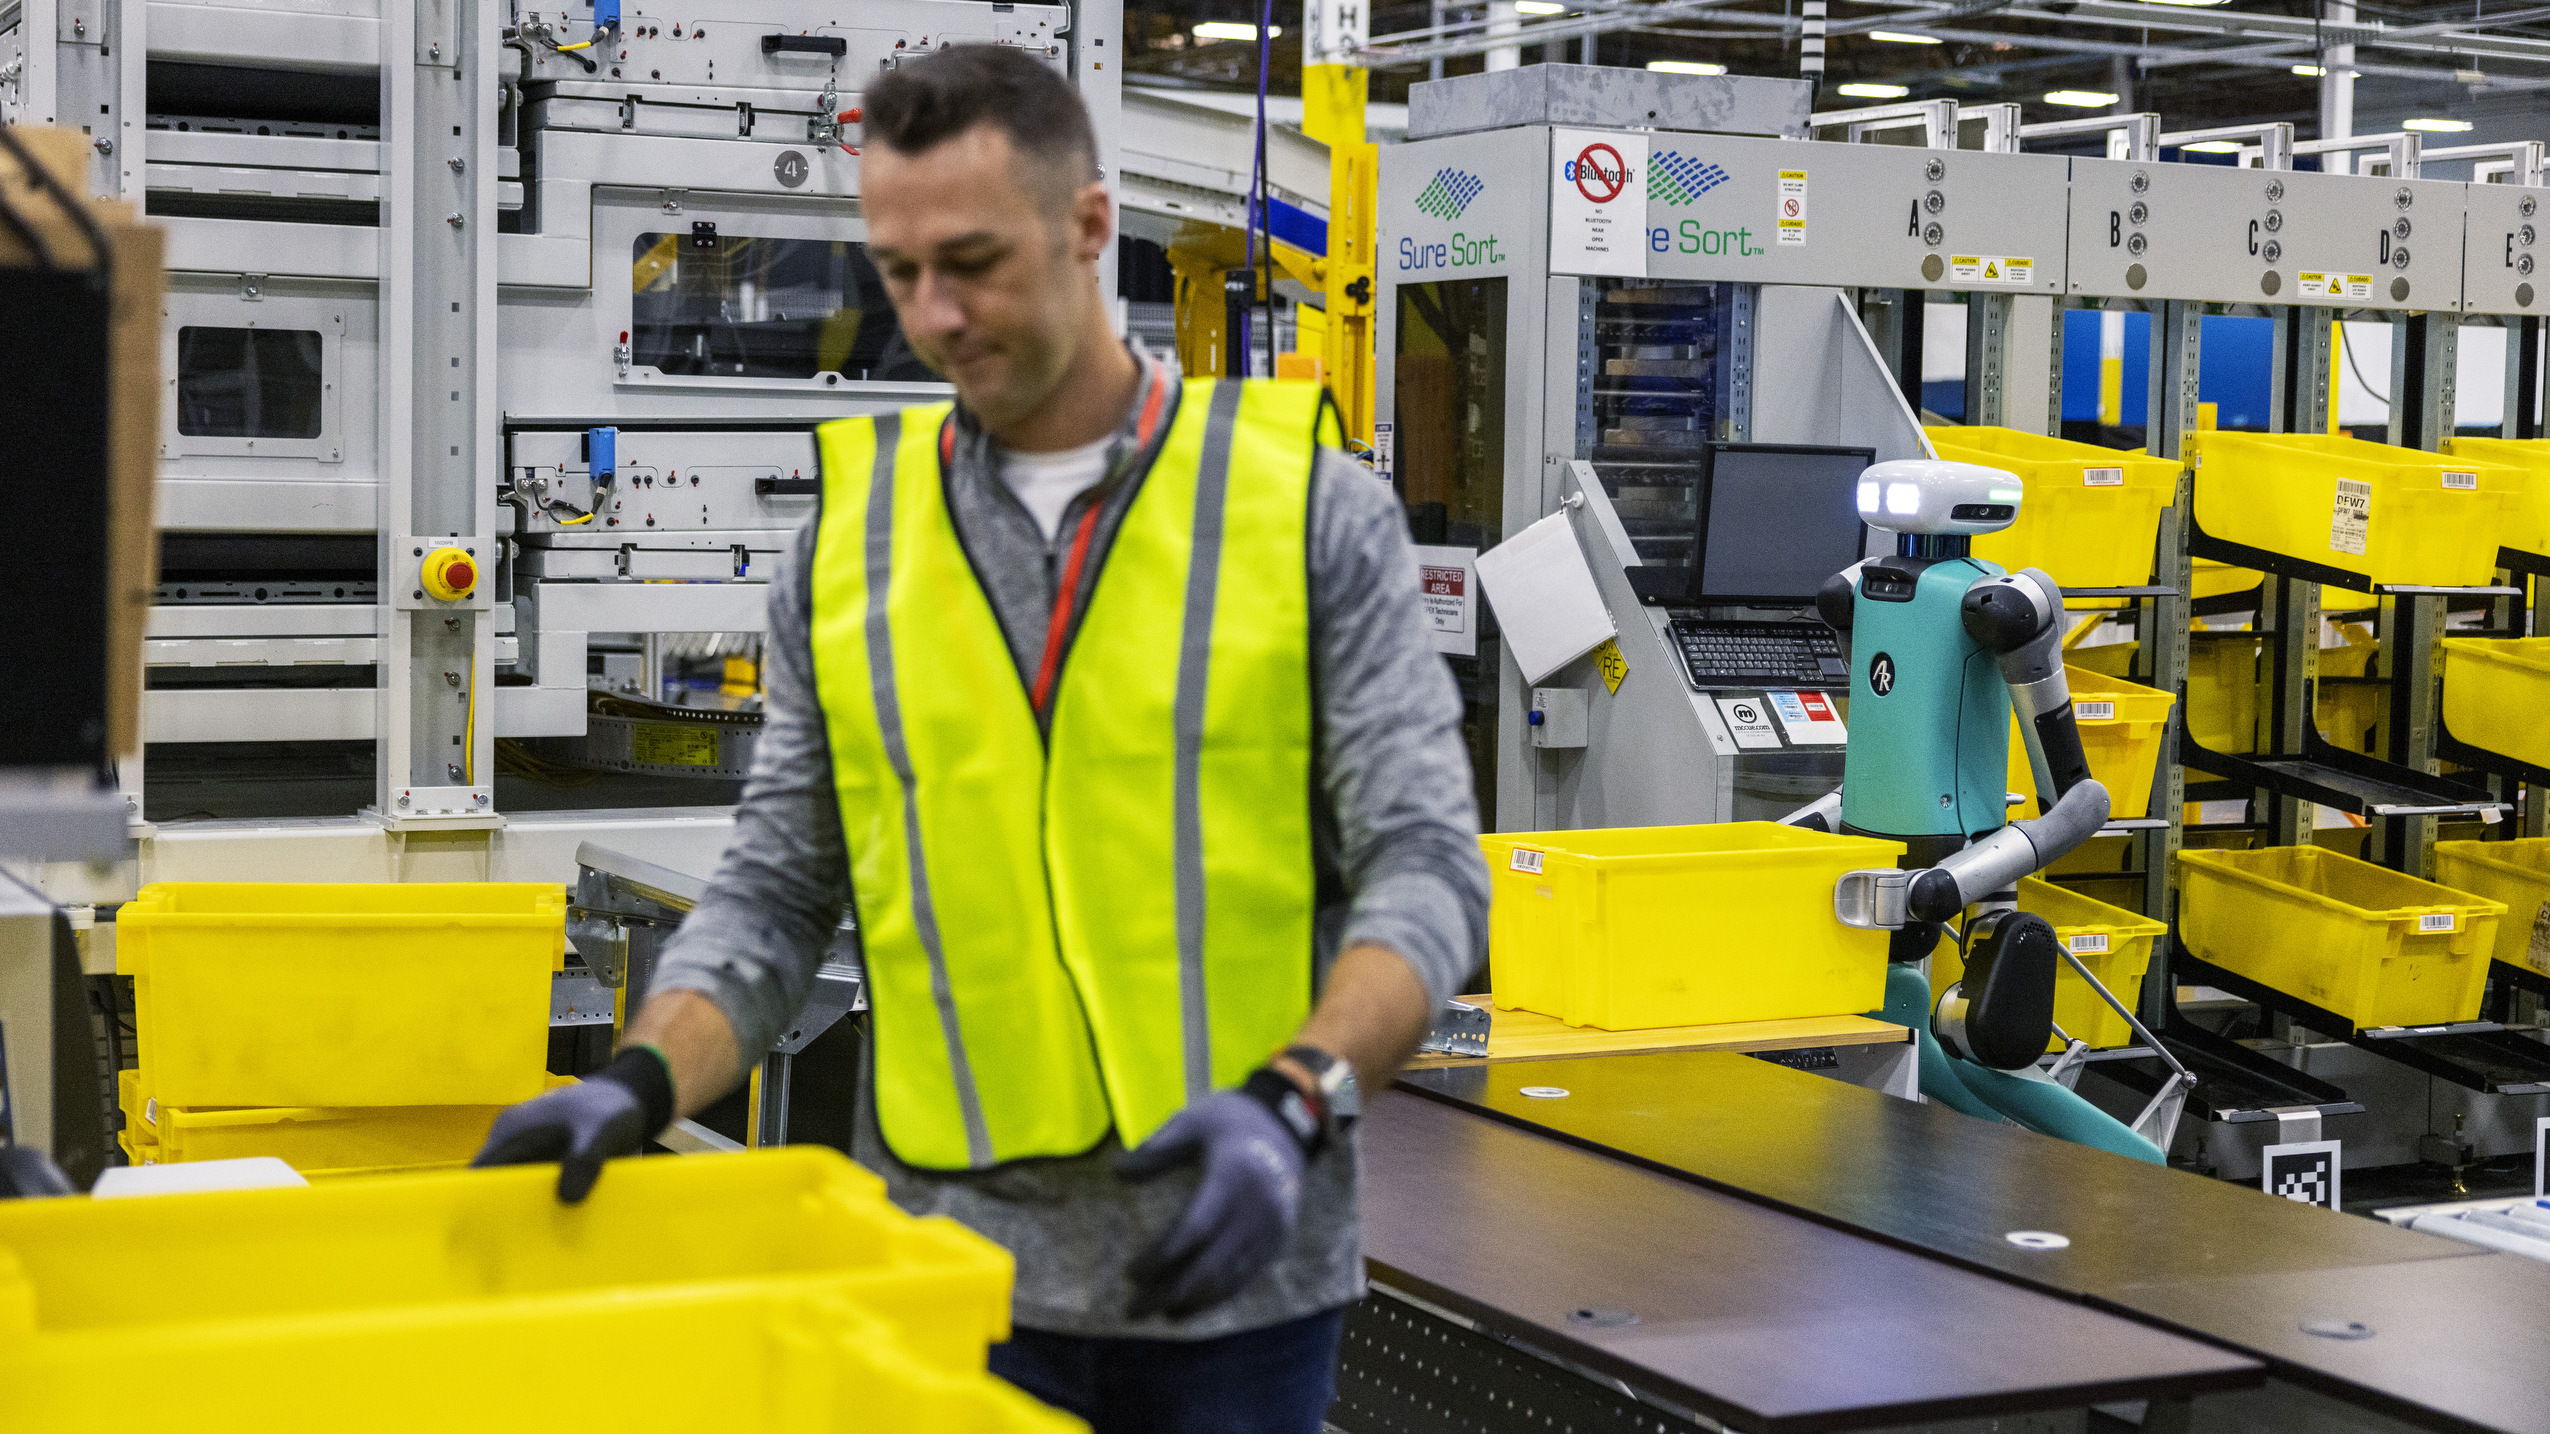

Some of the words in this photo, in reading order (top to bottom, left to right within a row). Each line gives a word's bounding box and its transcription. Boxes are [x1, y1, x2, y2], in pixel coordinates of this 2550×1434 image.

[1339, 5, 1356, 28] H
[785, 160, 797, 177] 4
[1908, 199, 1919, 236] A
[2110, 211, 2120, 247] B
[1400, 237, 1447, 270] Sure
[1452, 232, 1497, 266] Sort
[1679, 219, 1752, 256] Sort
[2249, 219, 2259, 255] C
[2380, 230, 2389, 265] D
[2506, 233, 2514, 267] E
[2337, 495, 2365, 508] DFW7
[1420, 569, 1463, 582] RESTRICTED
[1431, 583, 1451, 594] AREA
[1603, 656, 1621, 679] RE
